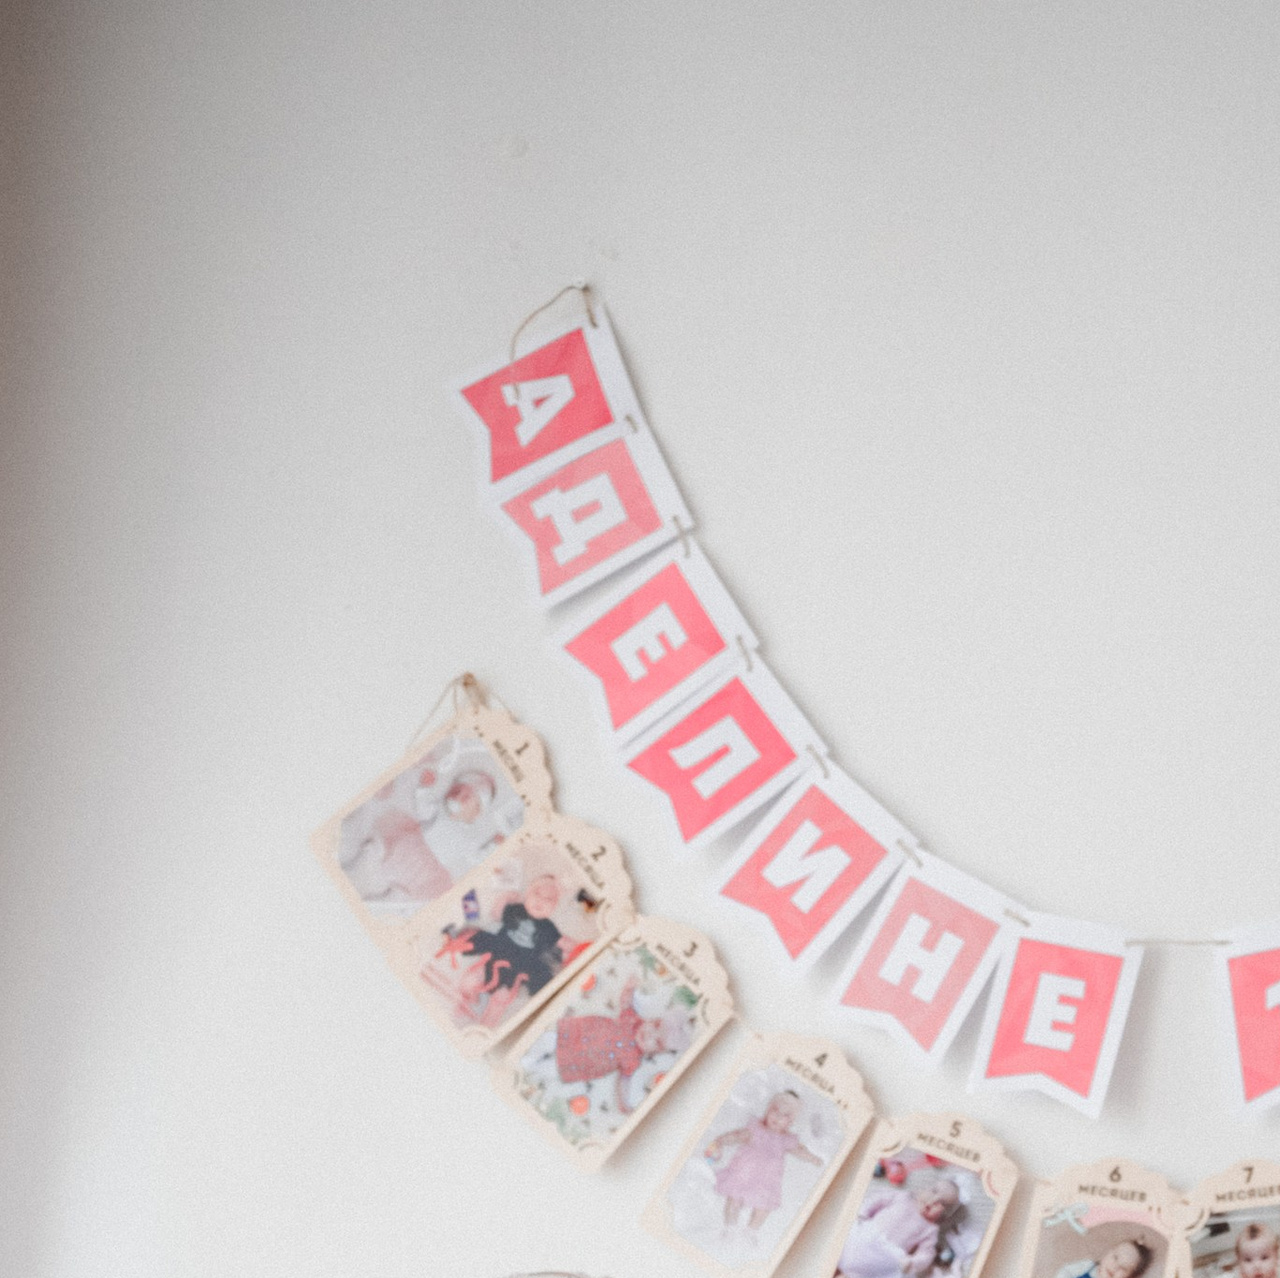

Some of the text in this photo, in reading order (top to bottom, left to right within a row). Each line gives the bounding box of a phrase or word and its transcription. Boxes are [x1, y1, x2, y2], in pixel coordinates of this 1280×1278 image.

[515, 742, 529, 756] 1
[591, 845, 607, 862] 2
[683, 942, 698, 958] 3
[814, 1052, 828, 1068] 4
[949, 1121, 963, 1138] 5
[1109, 1166, 1122, 1183] 6
[1242, 1166, 1255, 1184] 7
[1079, 1184, 1147, 1203] МЕСЯЦЕВ
